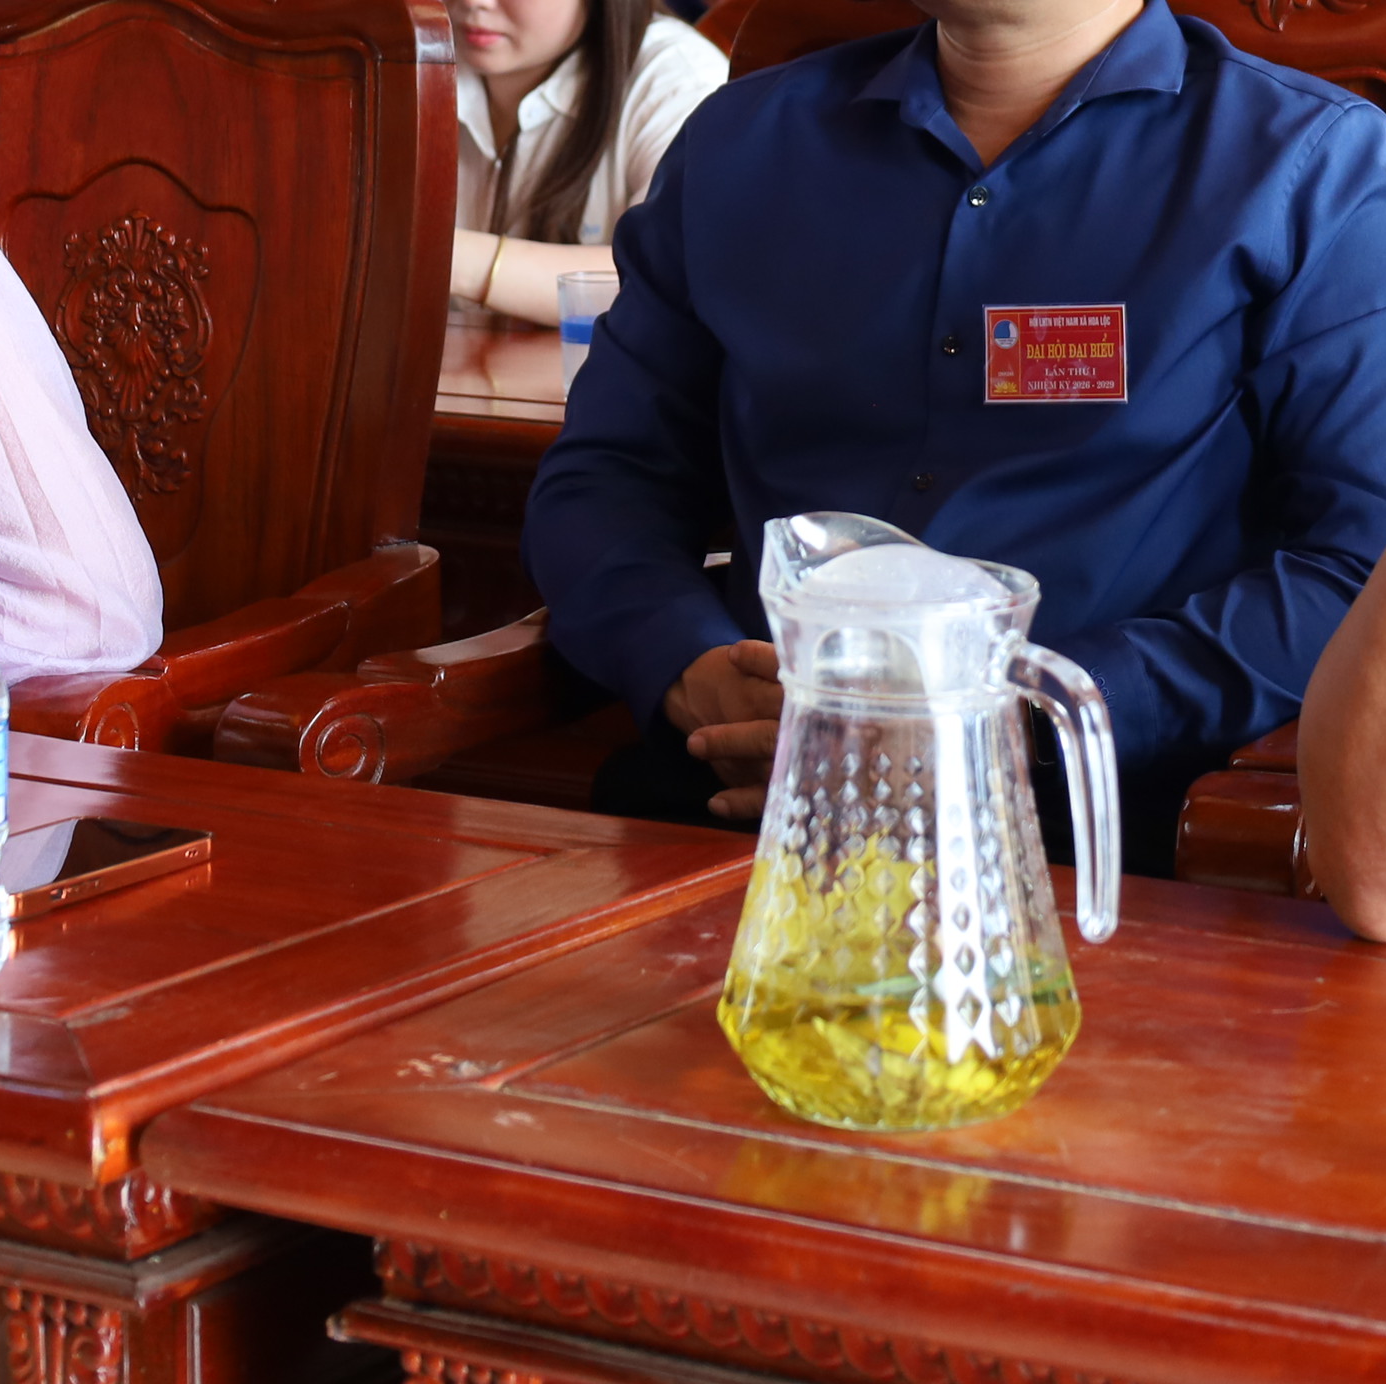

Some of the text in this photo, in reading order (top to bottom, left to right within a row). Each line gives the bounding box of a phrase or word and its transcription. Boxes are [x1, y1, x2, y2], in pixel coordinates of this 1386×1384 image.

[1053, 315, 1064, 328] VIỆT
[1066, 317, 1079, 326] NAM
[1088, 316, 1099, 326] HOA
[1026, 332, 1114, 362] ĐẠI HỘI ĐẠI BIỂU
[1028, 378, 1056, 392] NHIỆM
[1072, 381, 1090, 389] 2026
[1096, 380, 1115, 389] 2029
